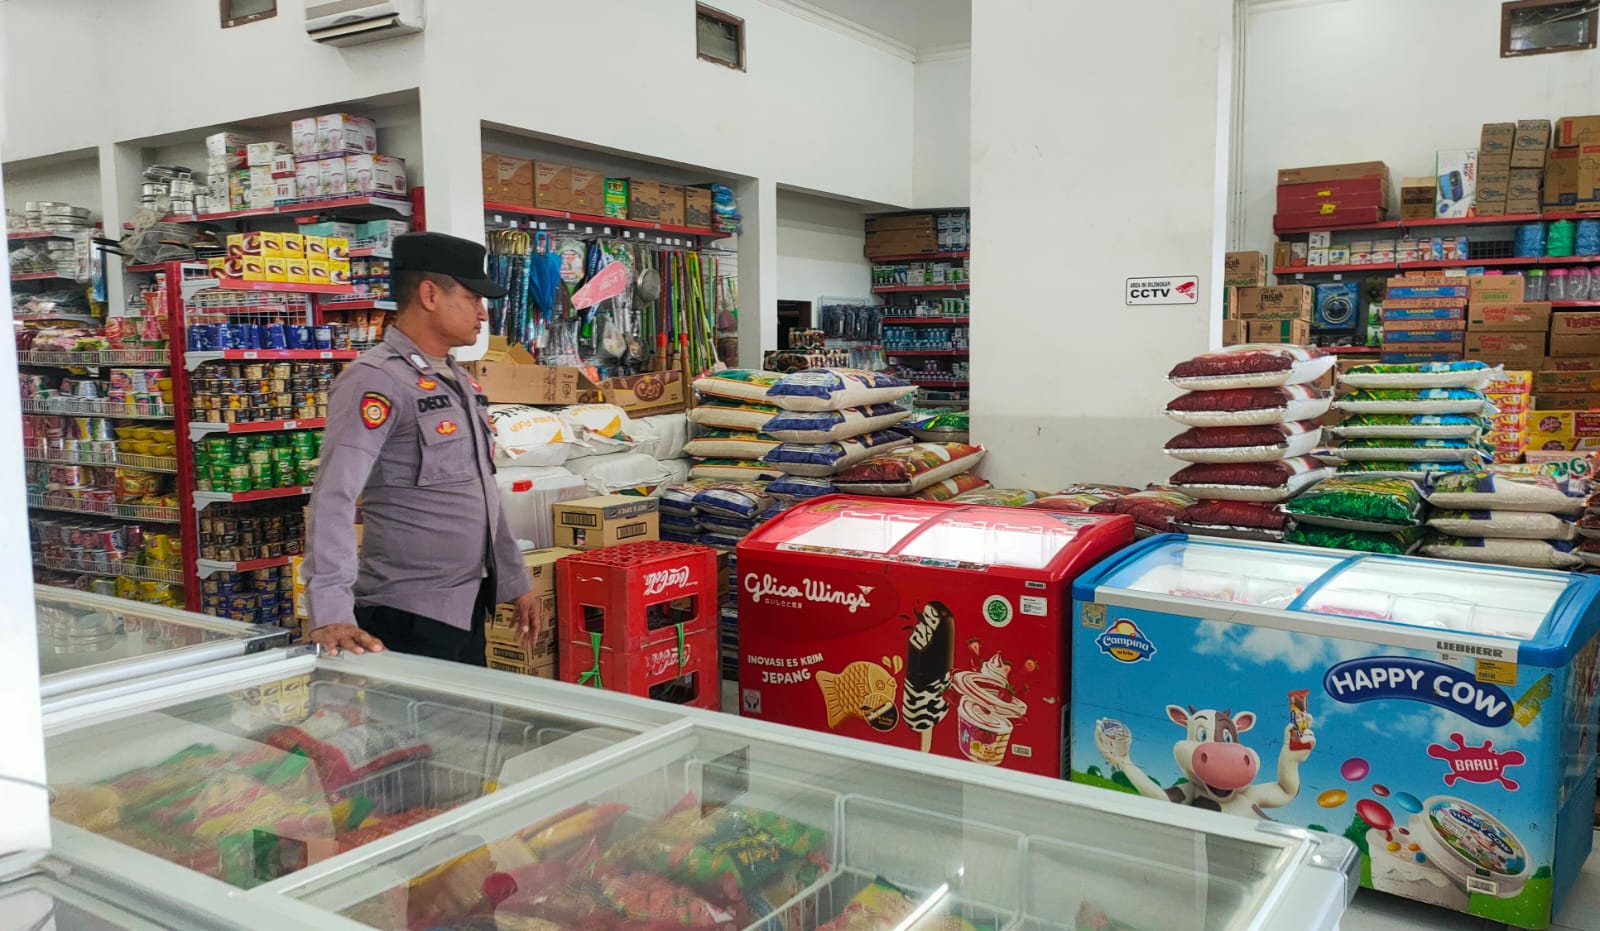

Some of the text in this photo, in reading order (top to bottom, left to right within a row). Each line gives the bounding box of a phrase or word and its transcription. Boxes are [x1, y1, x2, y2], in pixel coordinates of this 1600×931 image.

[1130, 288, 1171, 299] CCTV
[744, 572, 871, 613] Glico Wings
[1103, 635, 1149, 651] Campina
[1437, 641, 1503, 658] LIEBHERR
[748, 652, 824, 668] INOVASI ES KRIM
[761, 668, 812, 684] JEPANG
[1331, 667, 1507, 718] HAPPY COW
[1455, 758, 1500, 772] BARU!
[1487, 831, 1513, 853] COW
